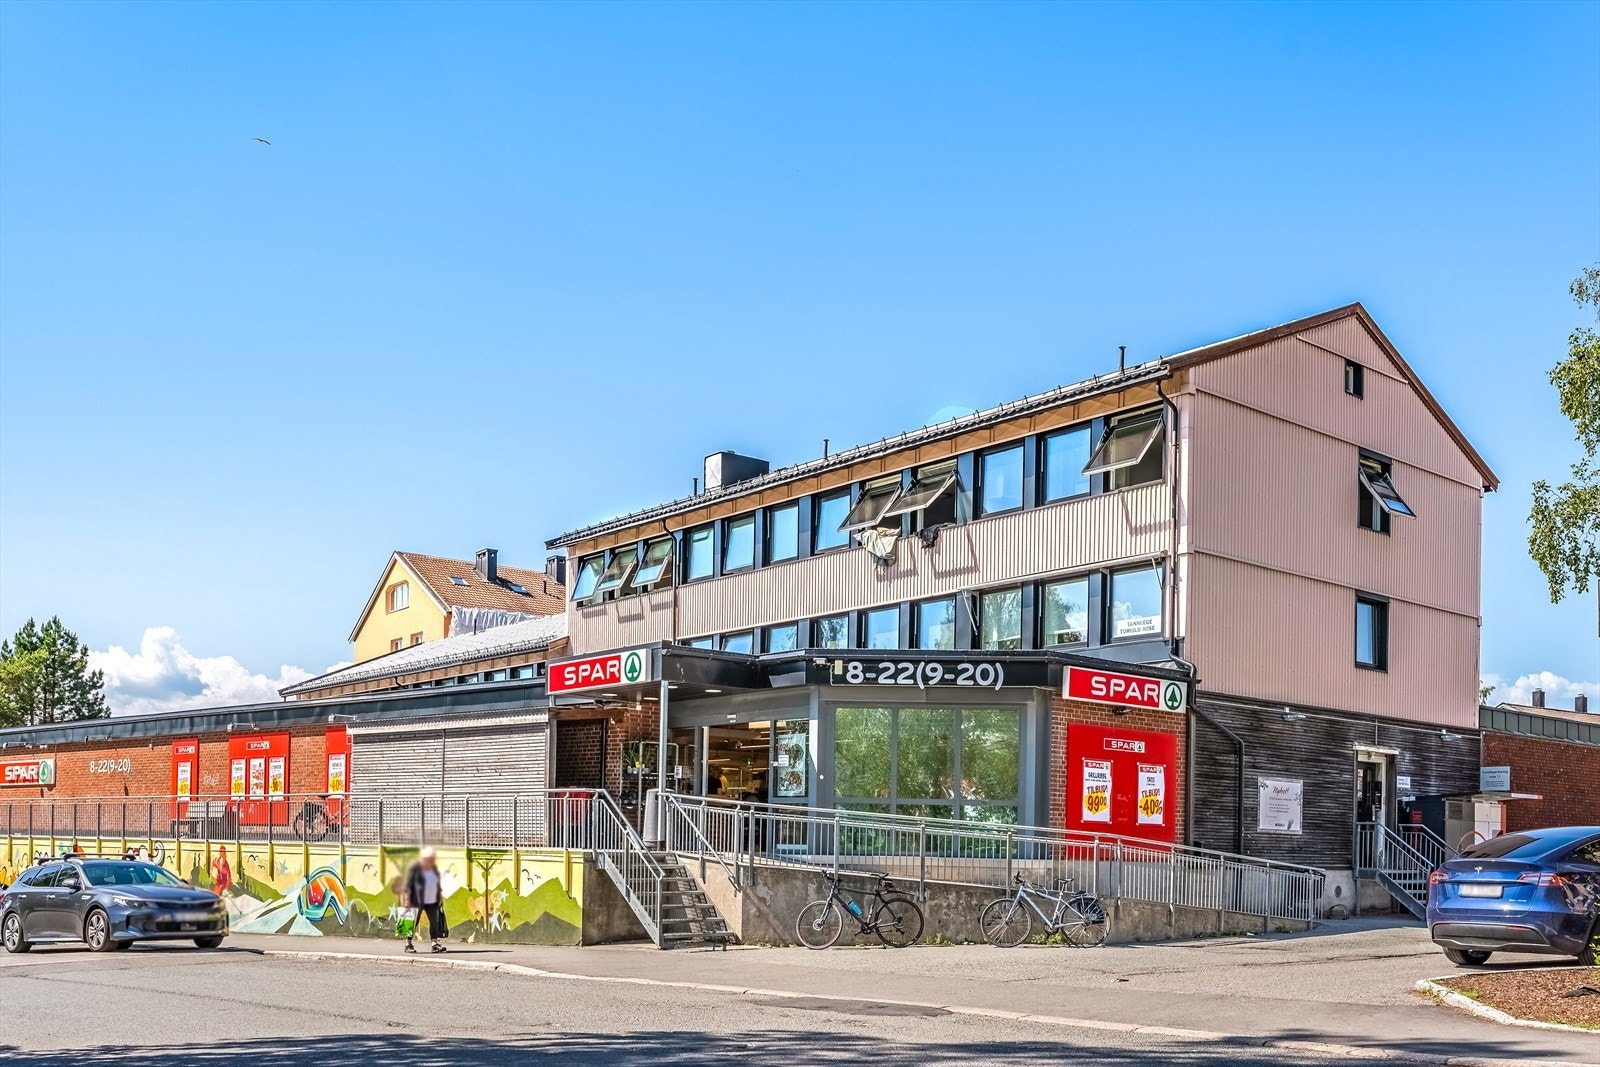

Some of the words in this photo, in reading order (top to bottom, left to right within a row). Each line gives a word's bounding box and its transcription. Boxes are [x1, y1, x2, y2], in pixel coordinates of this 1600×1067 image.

[564, 659, 620, 686] SPAR
[846, 661, 1004, 691] 8-22(9-20)
[1091, 675, 1159, 703] SPAR
[1111, 741, 1135, 750] SPAR
[4, 765, 38, 781] SPAR
[90, 758, 131, 774] 8-22(9-20)
[1139, 799, 1163, 815] -40%
